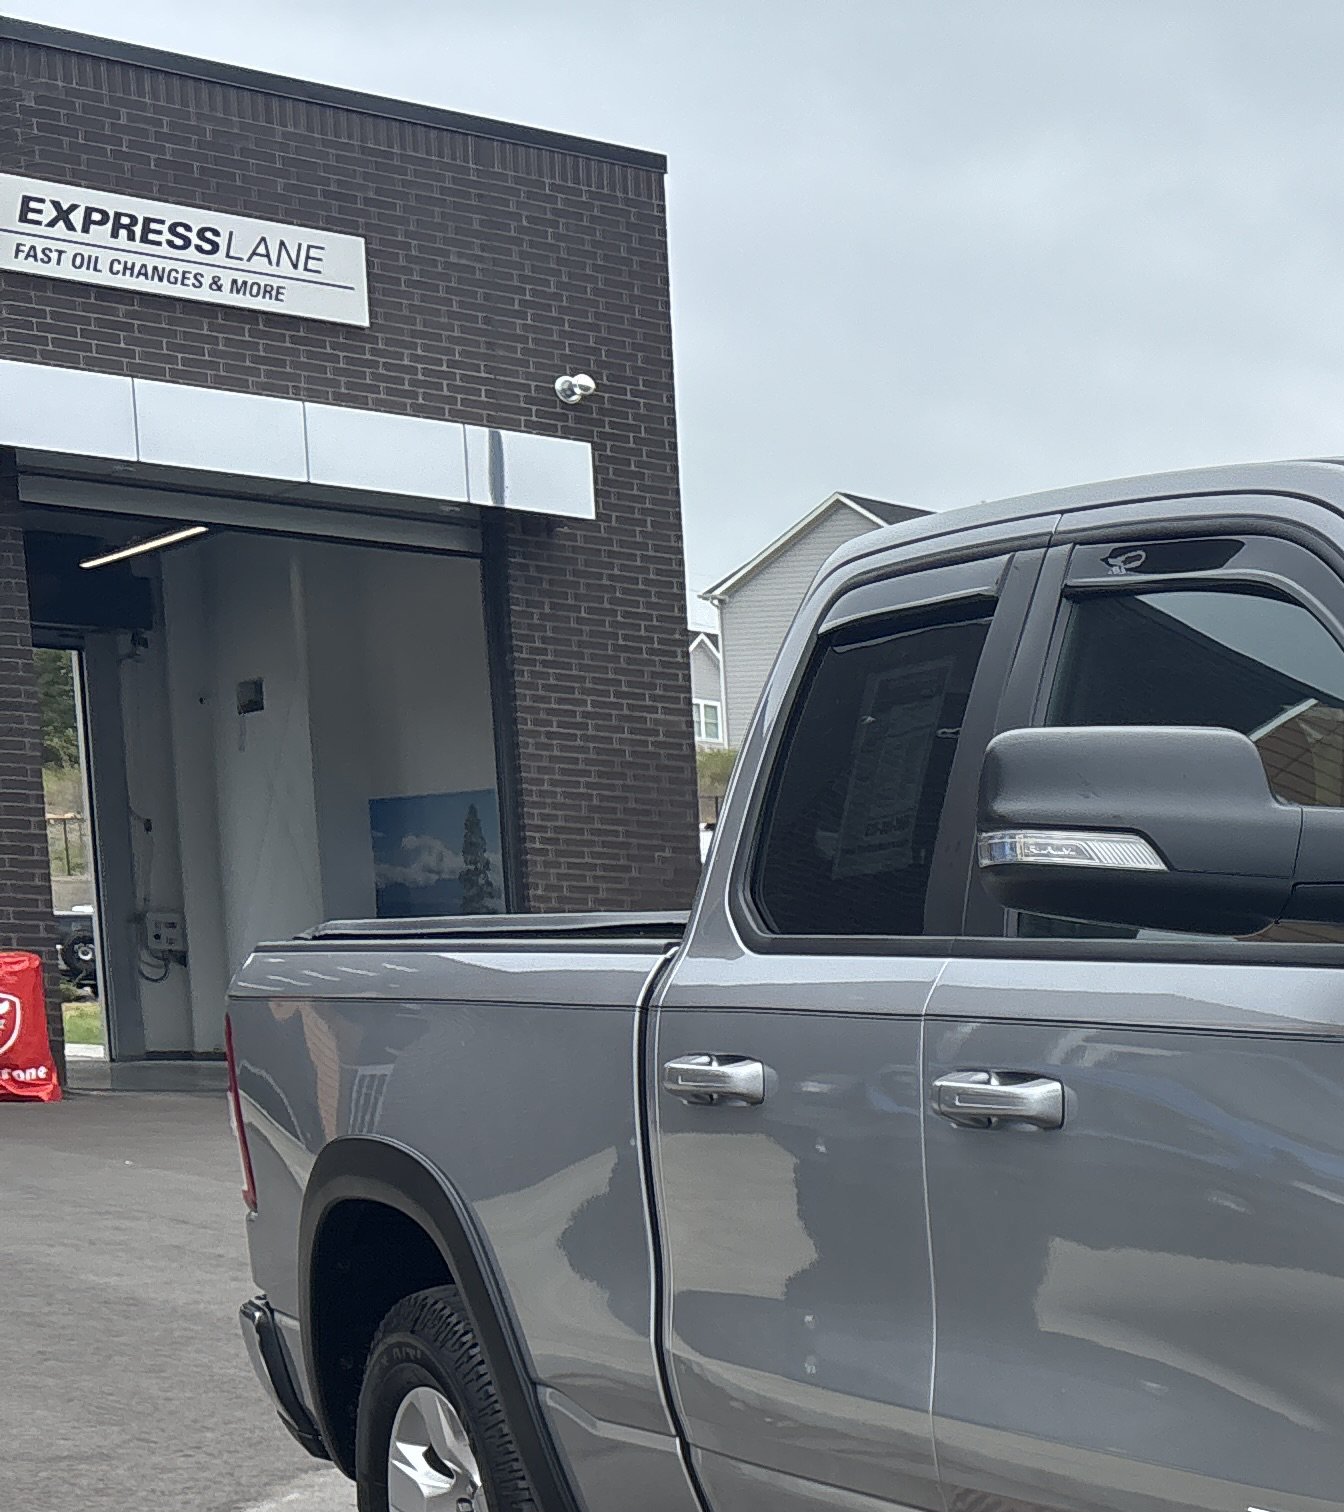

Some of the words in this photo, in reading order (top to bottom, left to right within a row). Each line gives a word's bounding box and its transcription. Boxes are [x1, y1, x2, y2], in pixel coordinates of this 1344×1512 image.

[14, 242, 66, 266] FAST
[71, 252, 103, 273] OIL
[109, 258, 204, 289] CHANGES
[208, 276, 224, 292] &
[229, 278, 287, 303] MORE
